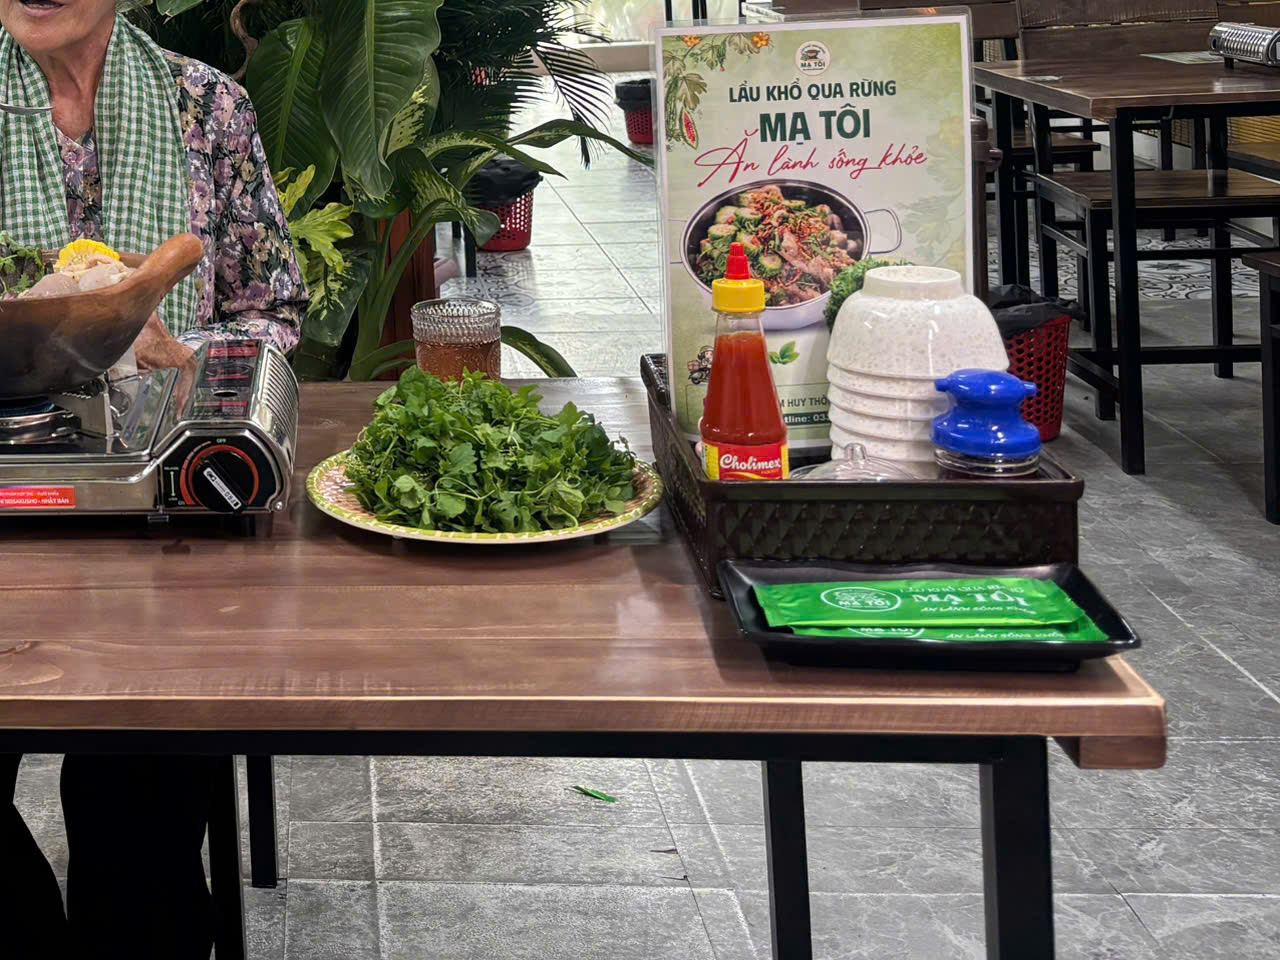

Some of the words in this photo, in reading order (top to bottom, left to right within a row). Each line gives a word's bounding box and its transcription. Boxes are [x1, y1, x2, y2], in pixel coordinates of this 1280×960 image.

[729, 80, 761, 102] LẨU
[766, 78, 802, 101] KHỔ
[807, 82, 844, 100] QUA
[849, 78, 897, 98] RỪNG
[759, 111, 811, 145] MẠ
[819, 103, 871, 140] TÔI
[693, 129, 760, 187] Ăn
[767, 144, 820, 176] lành
[828, 148, 881, 179] sống
[880, 143, 928, 169] khỏe
[787, 397, 807, 407] HUY
[783, 415, 811, 424] tline:
[720, 454, 781, 470] Cholimex
